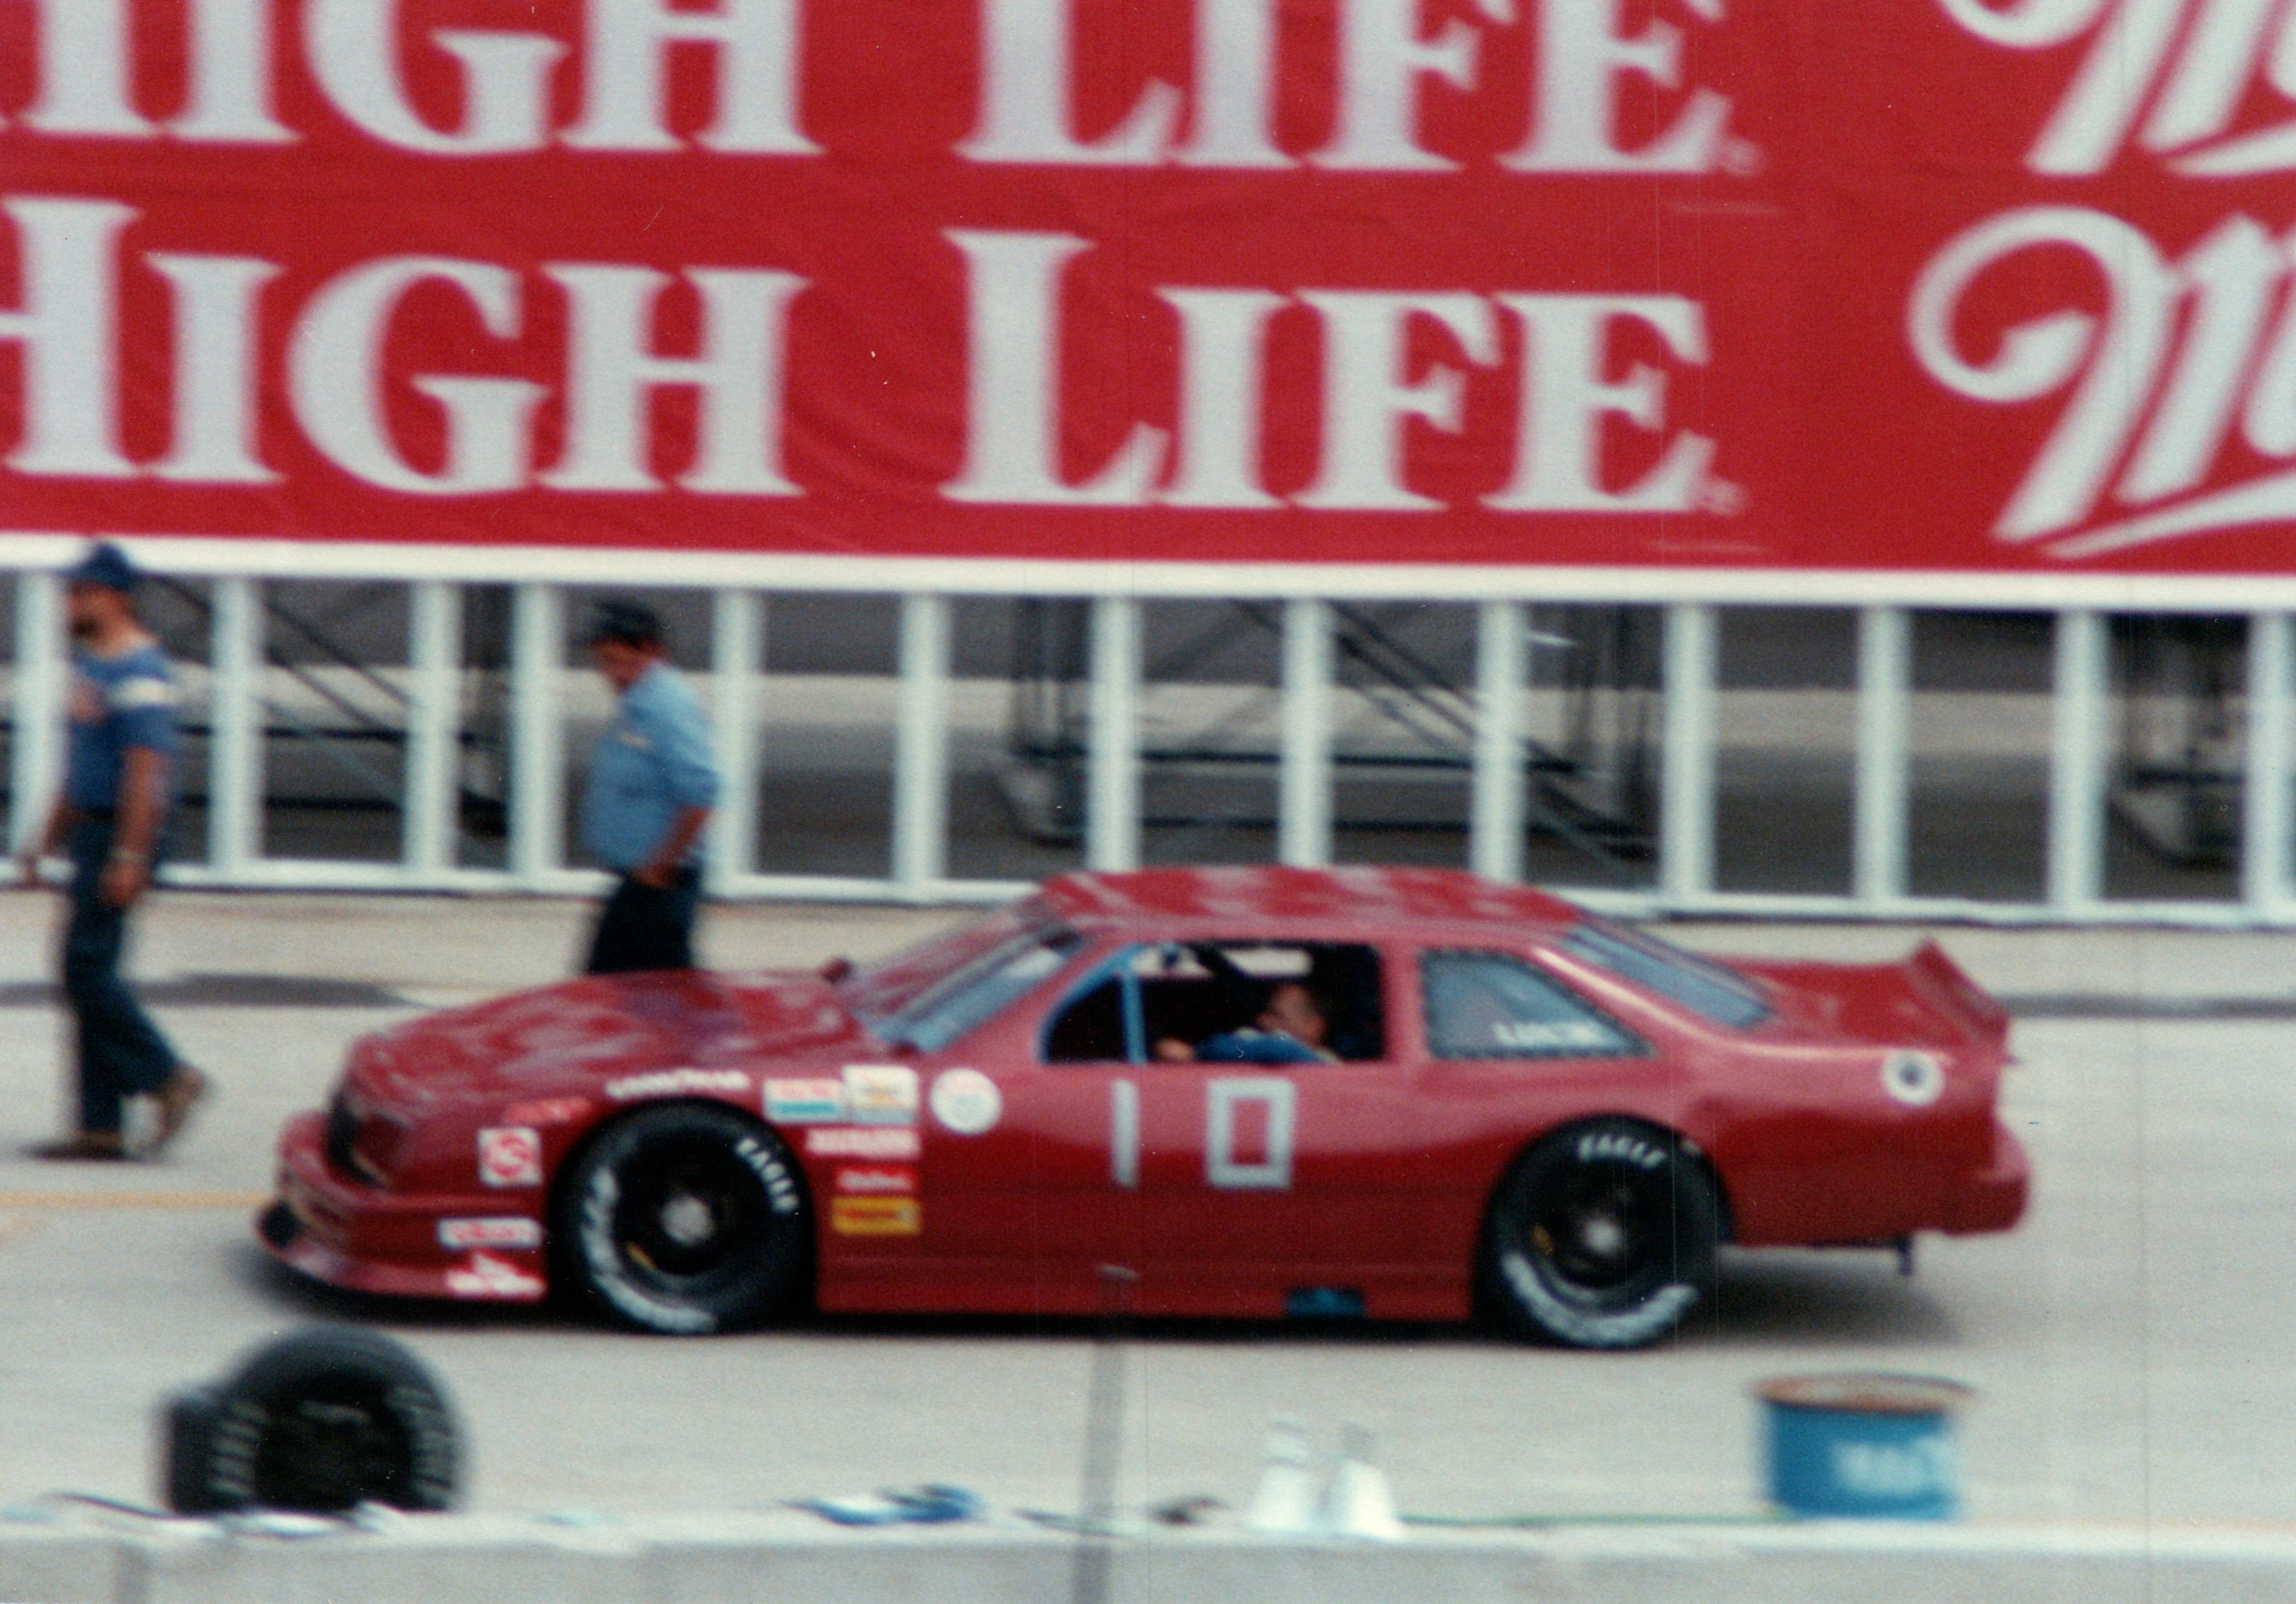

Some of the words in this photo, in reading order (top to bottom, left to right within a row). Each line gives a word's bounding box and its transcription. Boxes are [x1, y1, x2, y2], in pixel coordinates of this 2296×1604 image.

[951, 0, 1733, 174] LIFE
[937, 228, 1716, 513] LIFE
[1112, 1078, 1293, 1189] 10
